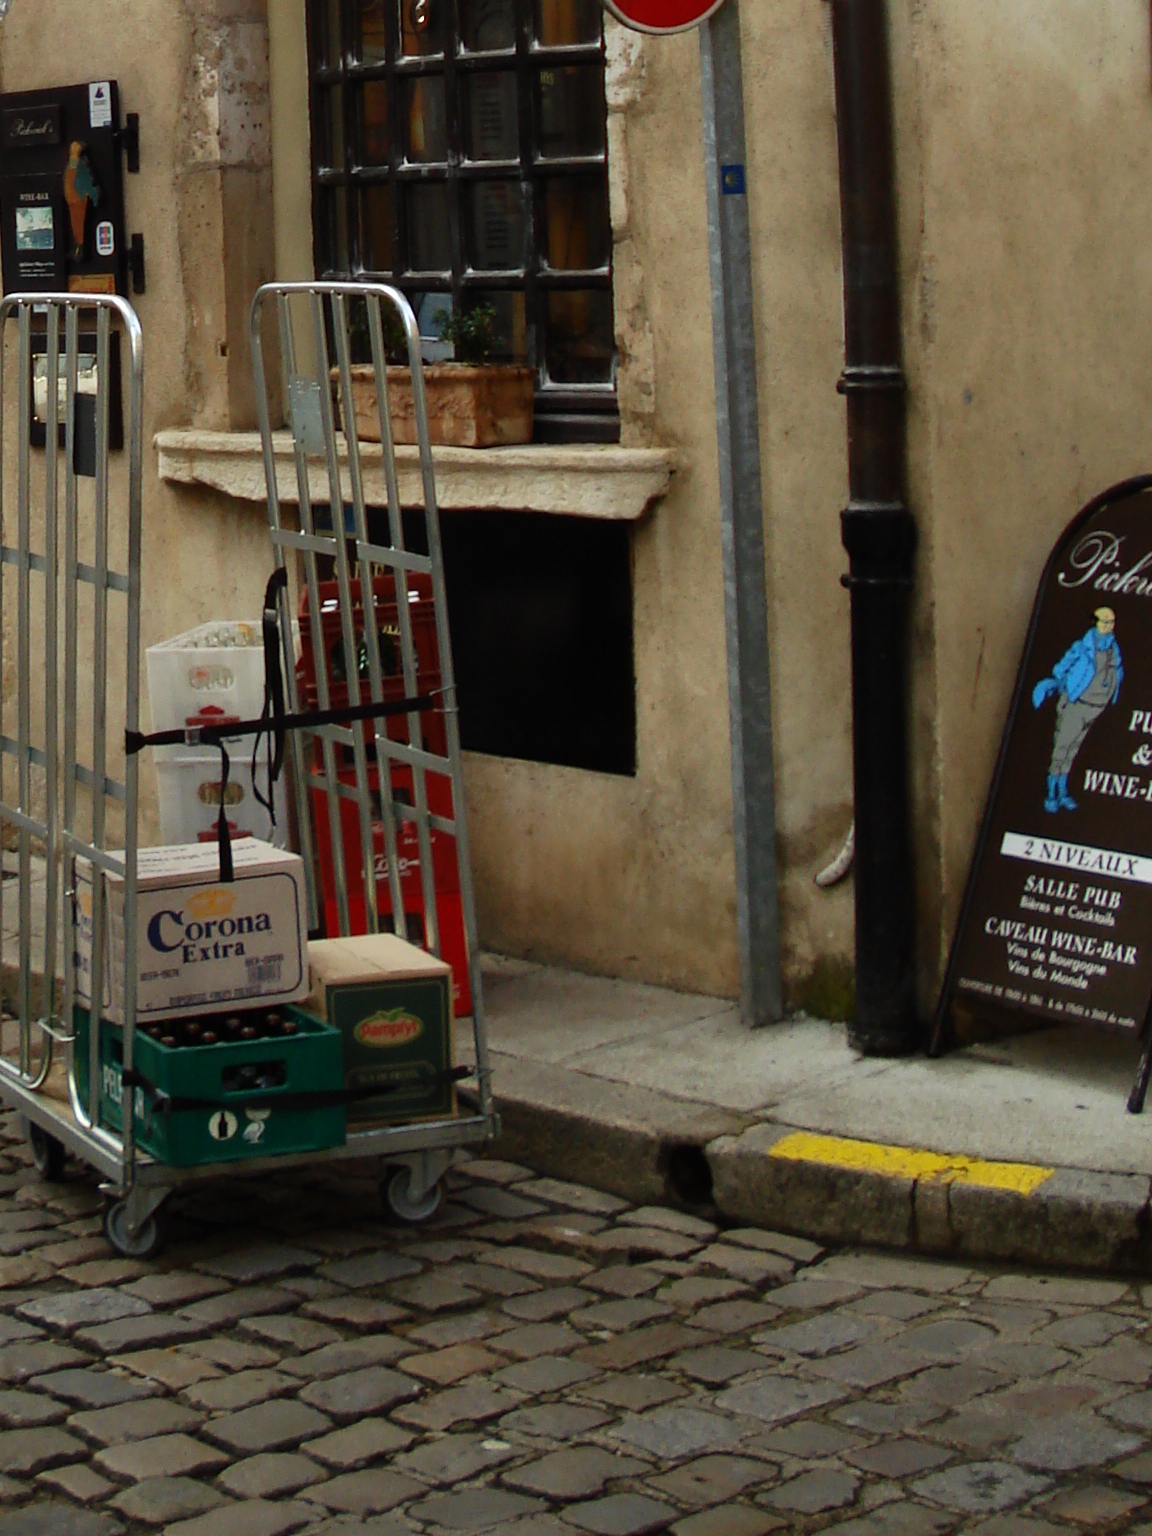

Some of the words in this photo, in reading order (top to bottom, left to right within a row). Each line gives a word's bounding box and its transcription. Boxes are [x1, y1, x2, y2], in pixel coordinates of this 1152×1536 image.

[1023, 839, 1035, 856] 2
[1040, 842, 1139, 877] NIVEAUX
[1023, 874, 1080, 901] SALLE
[1083, 885, 1123, 910] PUB
[147, 910, 272, 953] Corona
[984, 916, 1049, 945] CAVEAU
[1051, 929, 1138, 965] WINE-BAR
[182, 940, 246, 964] Extra
[1006, 940, 1029, 959] Vins
[1030, 947, 1047, 963] de
[1048, 950, 1108, 976] Bourgogne
[1007, 959, 1030, 977] Vins
[1032, 964, 1048, 980] du
[1049, 969, 1090, 990] Monde
